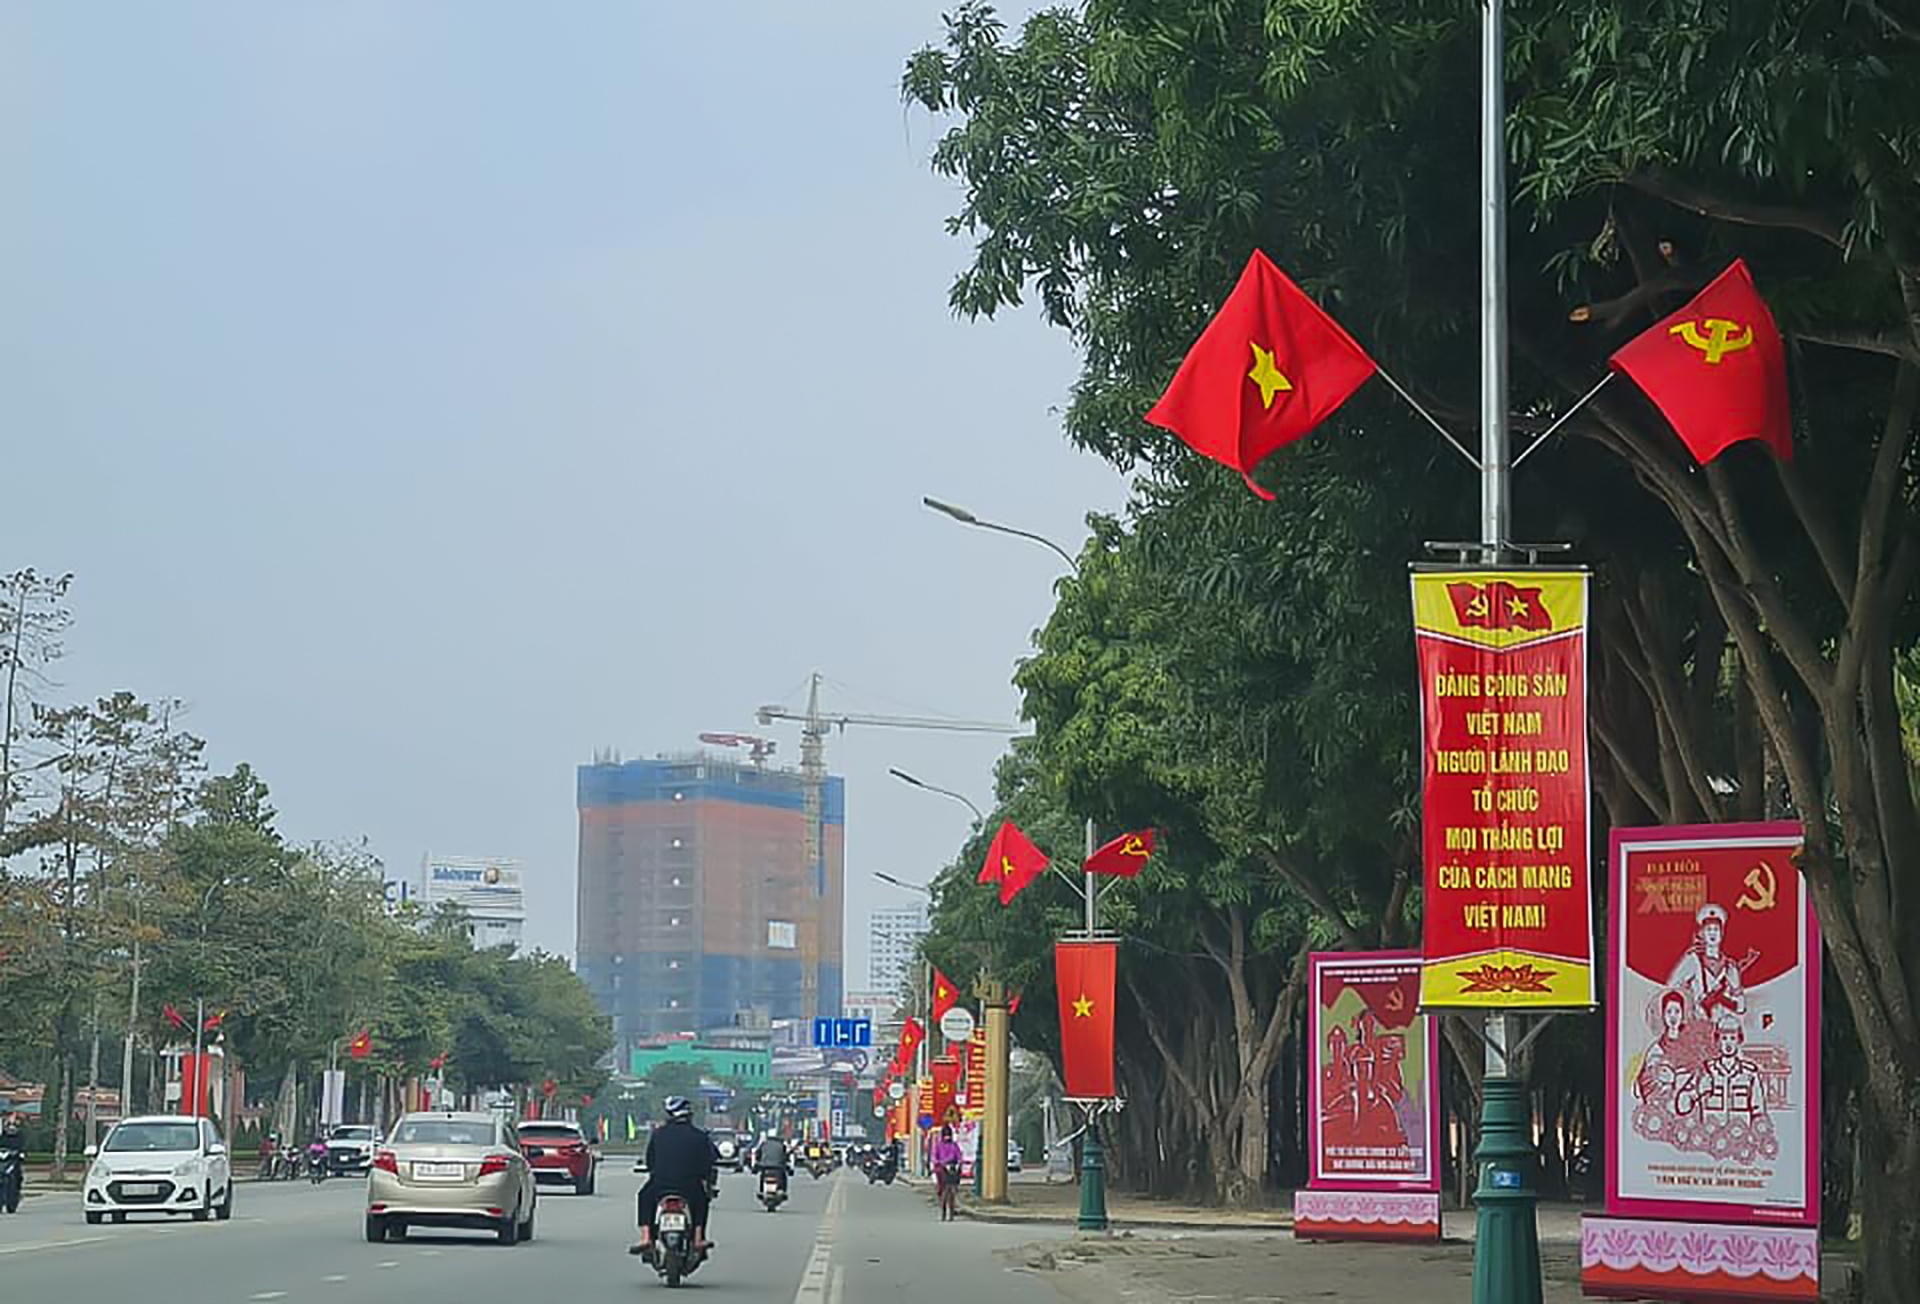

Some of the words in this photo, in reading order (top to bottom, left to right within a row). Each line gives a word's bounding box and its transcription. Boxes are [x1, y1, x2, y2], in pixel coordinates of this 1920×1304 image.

[1435, 667, 1480, 697] ĐẢNG
[1485, 669, 1528, 702] CỘNG
[1533, 667, 1567, 697] SẢN
[1467, 708, 1500, 740] VIỆT
[1503, 712, 1542, 735] NAM
[1437, 746, 1485, 773] NGƯỜI
[1535, 749, 1569, 777] ĐẠO
[1472, 780, 1492, 812] TỔ
[1497, 785, 1539, 812] CHỨC
[1446, 826, 1477, 855] MỌI
[1482, 819, 1533, 851] THẮNG
[1537, 826, 1563, 855] LỢI
[1439, 858, 1471, 888] CỦA
[1475, 861, 1517, 888] CÁCH
[1523, 865, 1572, 894] MẠNG
[1463, 901, 1499, 933] VIỆT
[1502, 905, 1546, 929] NAM!
